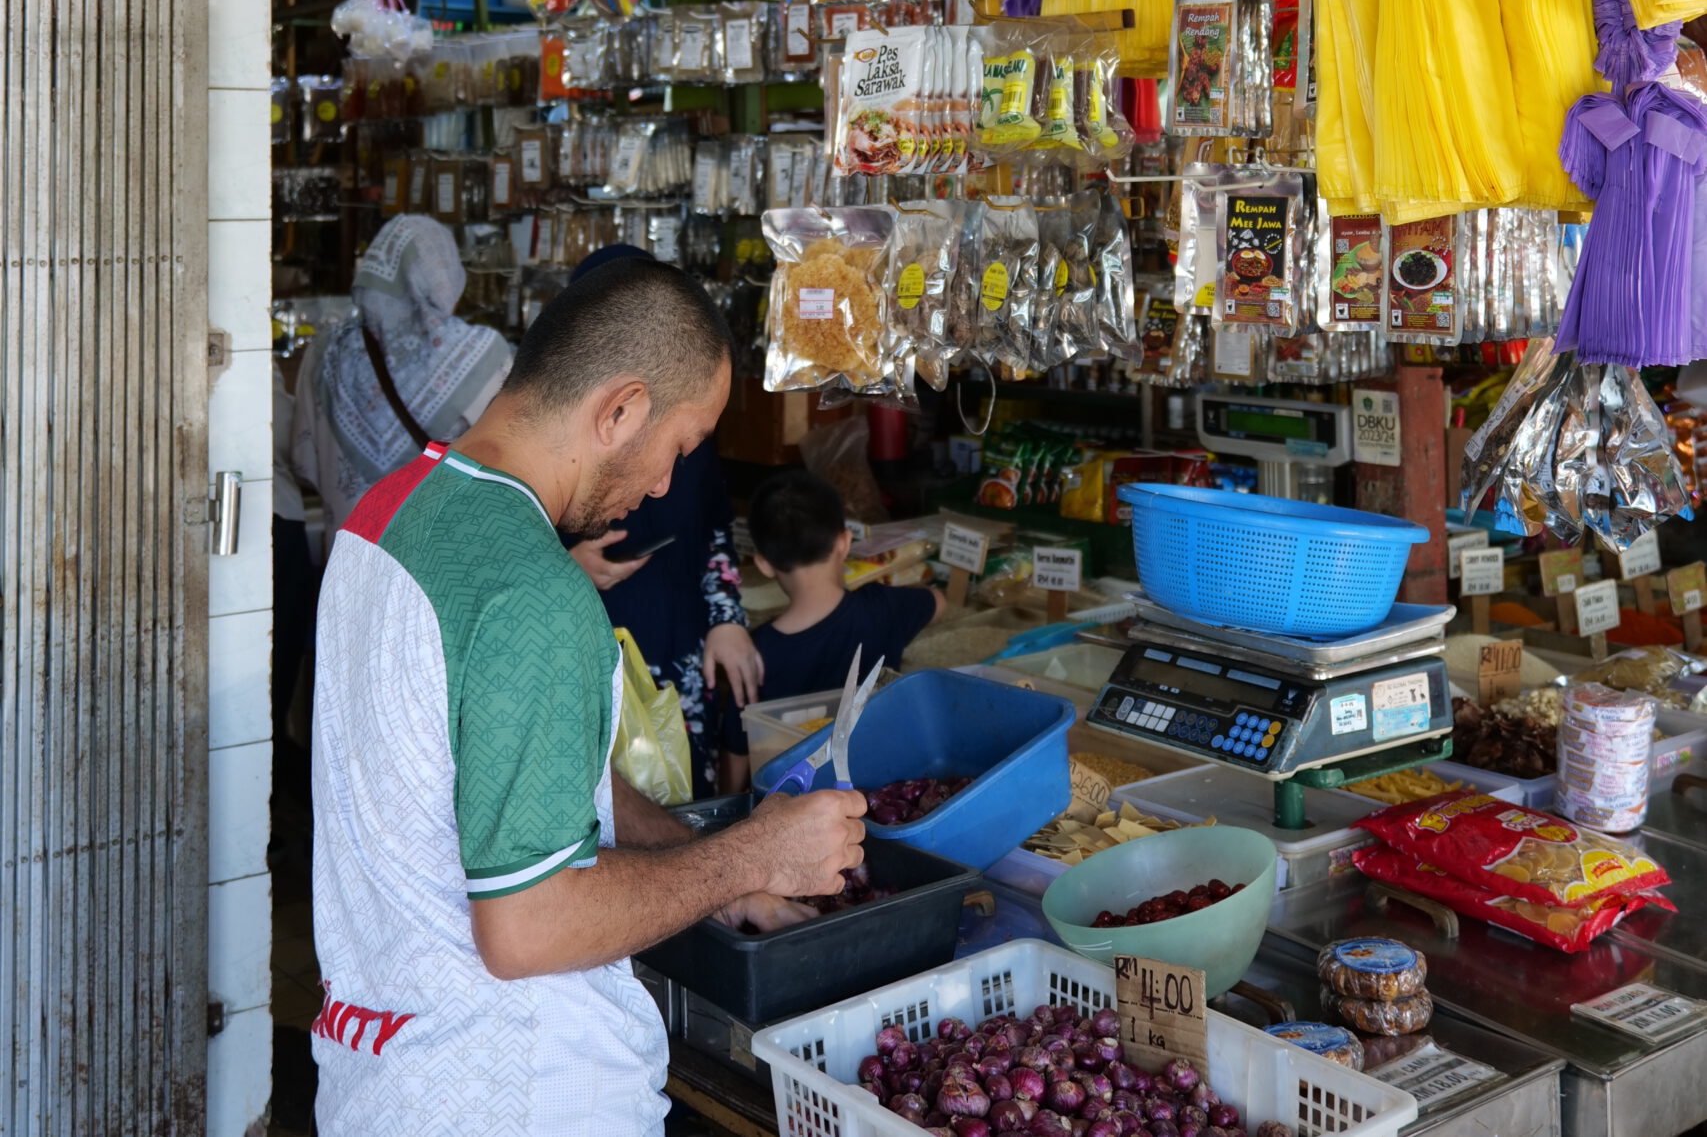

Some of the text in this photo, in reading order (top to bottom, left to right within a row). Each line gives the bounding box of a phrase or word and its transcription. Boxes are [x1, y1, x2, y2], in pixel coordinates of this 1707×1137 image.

[1188, 11, 1220, 23] Rempah
[1185, 26, 1220, 39] Rendang
[878, 45, 898, 64] Pes
[865, 61, 901, 82] Laksa
[854, 69, 907, 97] Sarawak
[1235, 200, 1277, 214] REMPAH
[1230, 217, 1282, 230] MEE JAWA
[1357, 414, 1396, 430] DBKU
[1358, 429, 1395, 443] 2023/24
[1114, 957, 1138, 980] RM
[312, 996, 417, 1056] NITY
